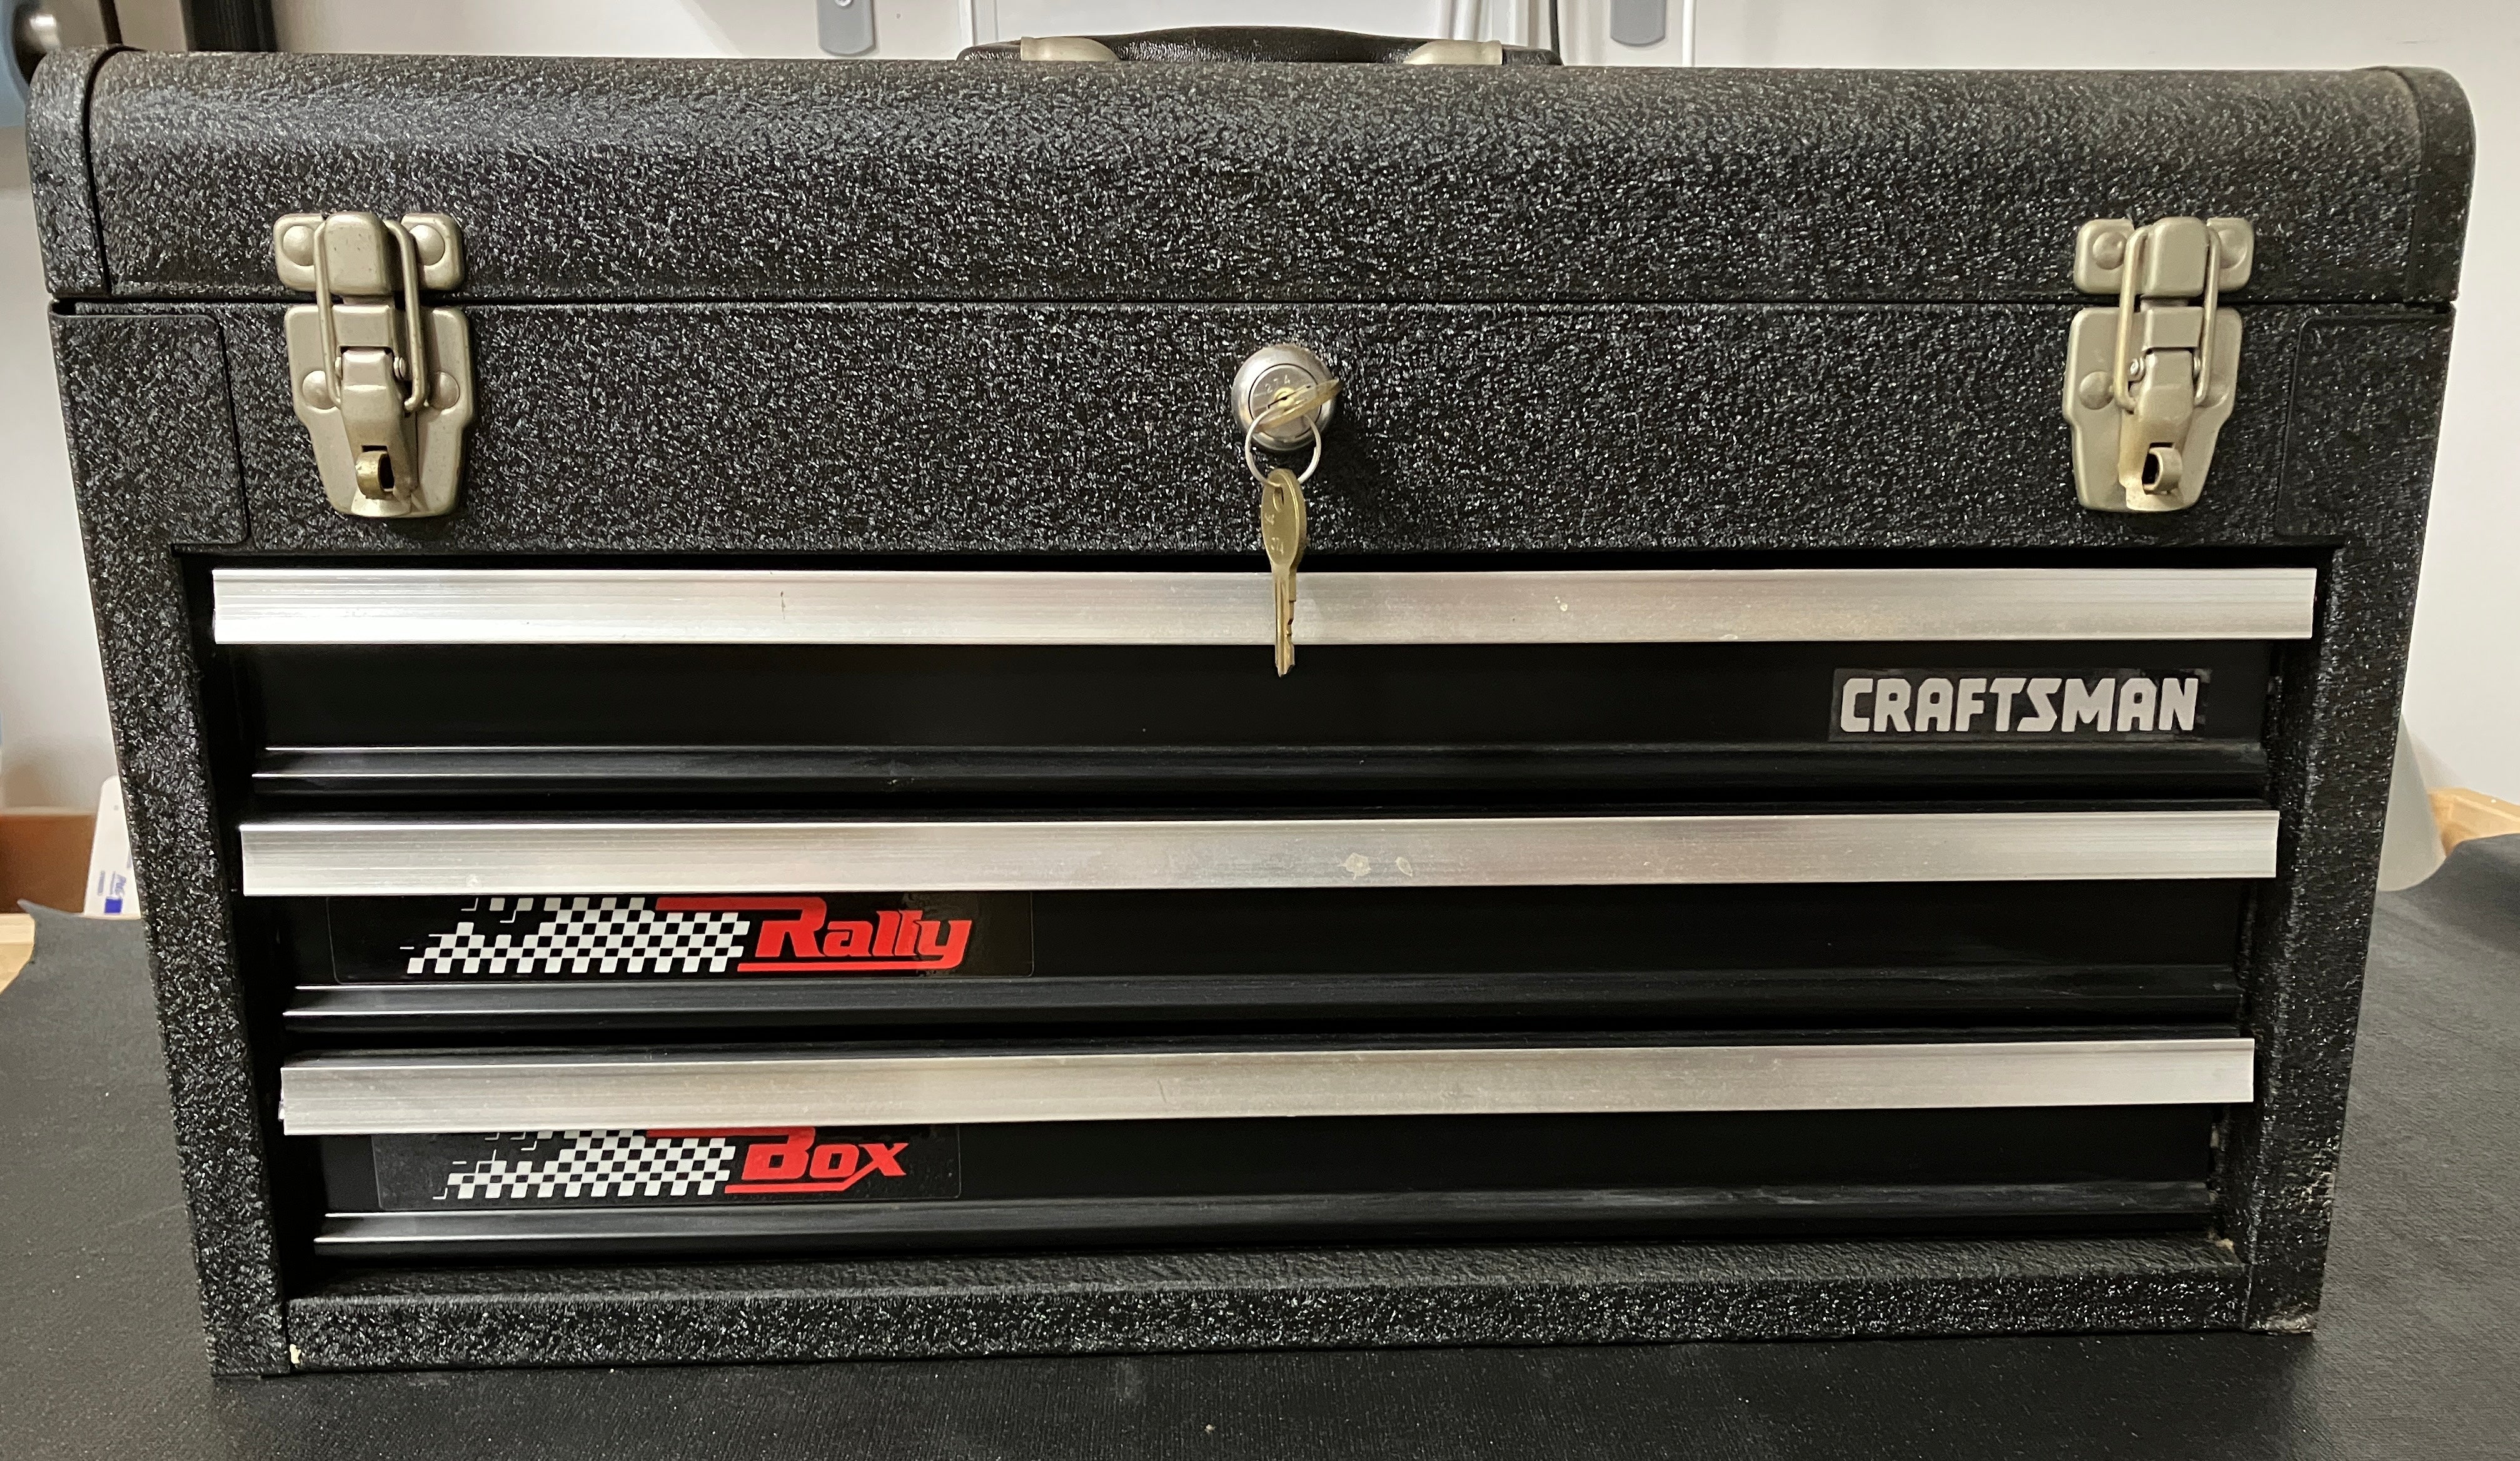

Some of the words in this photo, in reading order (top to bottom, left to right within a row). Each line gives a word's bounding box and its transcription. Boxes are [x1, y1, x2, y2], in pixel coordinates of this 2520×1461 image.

[1264, 374, 1291, 394] 274
[1840, 677, 2199, 732] CRAFTSMAN
[656, 896, 972, 972] Rally
[647, 1127, 909, 1193] Box
